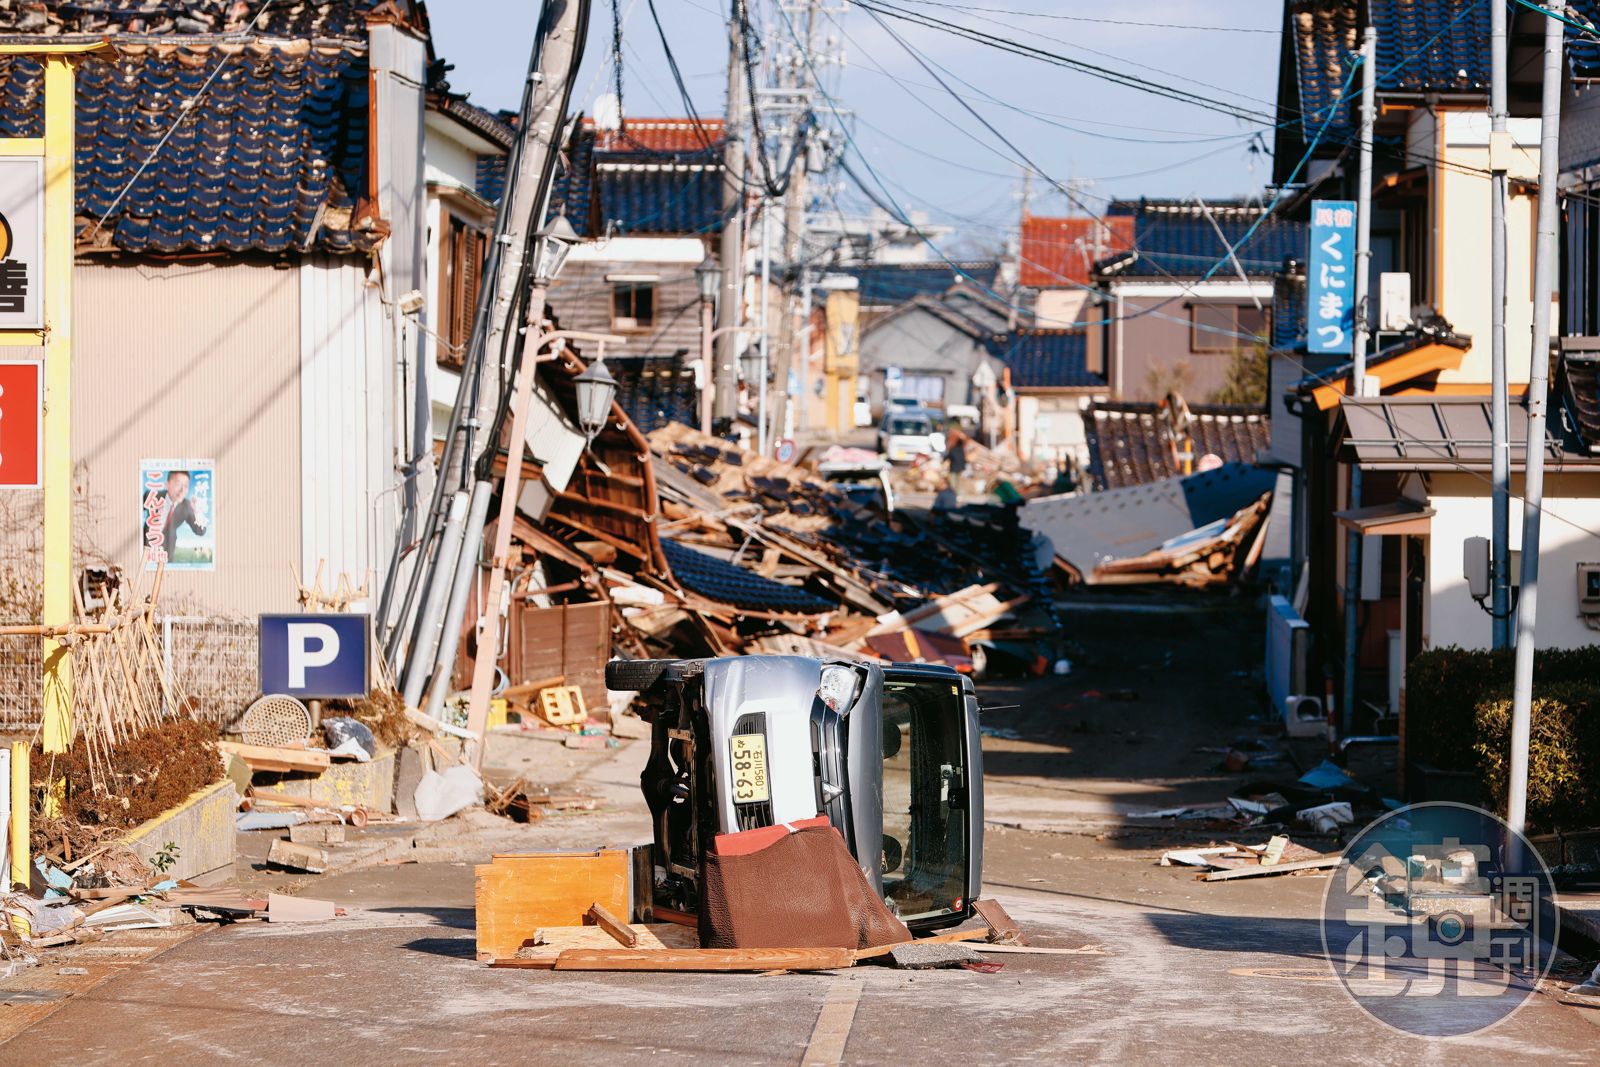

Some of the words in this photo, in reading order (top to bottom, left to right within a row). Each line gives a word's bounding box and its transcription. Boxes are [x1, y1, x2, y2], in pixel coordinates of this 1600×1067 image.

[1317, 232, 1346, 348] くにまつ
[287, 622, 340, 689] P
[734, 750, 753, 798] 58-63
